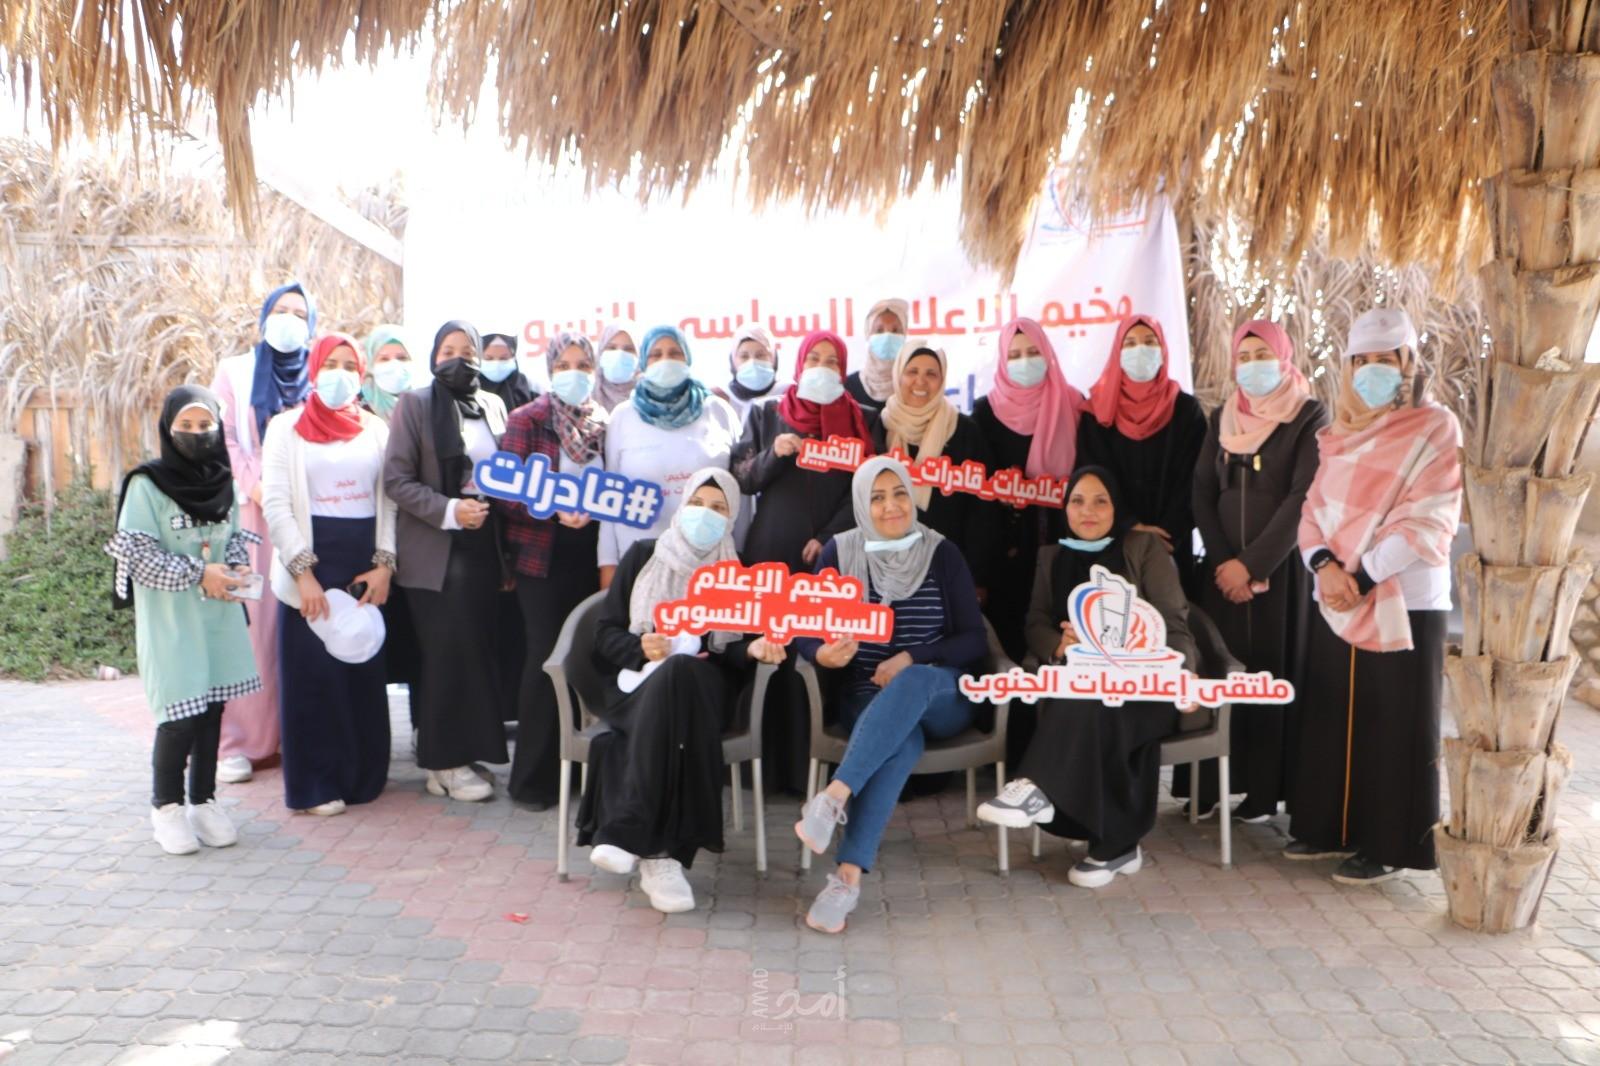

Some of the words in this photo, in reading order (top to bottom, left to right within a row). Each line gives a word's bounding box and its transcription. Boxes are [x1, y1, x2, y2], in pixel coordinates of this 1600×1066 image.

[907, 293, 1018, 348] الإعلا
[1039, 287, 1132, 338] مخيم
[480, 457, 658, 524] #قادرات
[694, 566, 783, 601] الإعلام
[789, 575, 857, 603] مخيم
[660, 601, 762, 631] النسوي
[769, 607, 887, 639] السياسي
[964, 670, 1058, 699] الجنوب
[1070, 671, 1187, 705] إعلاميات
[1199, 675, 1289, 703] ملتقى
